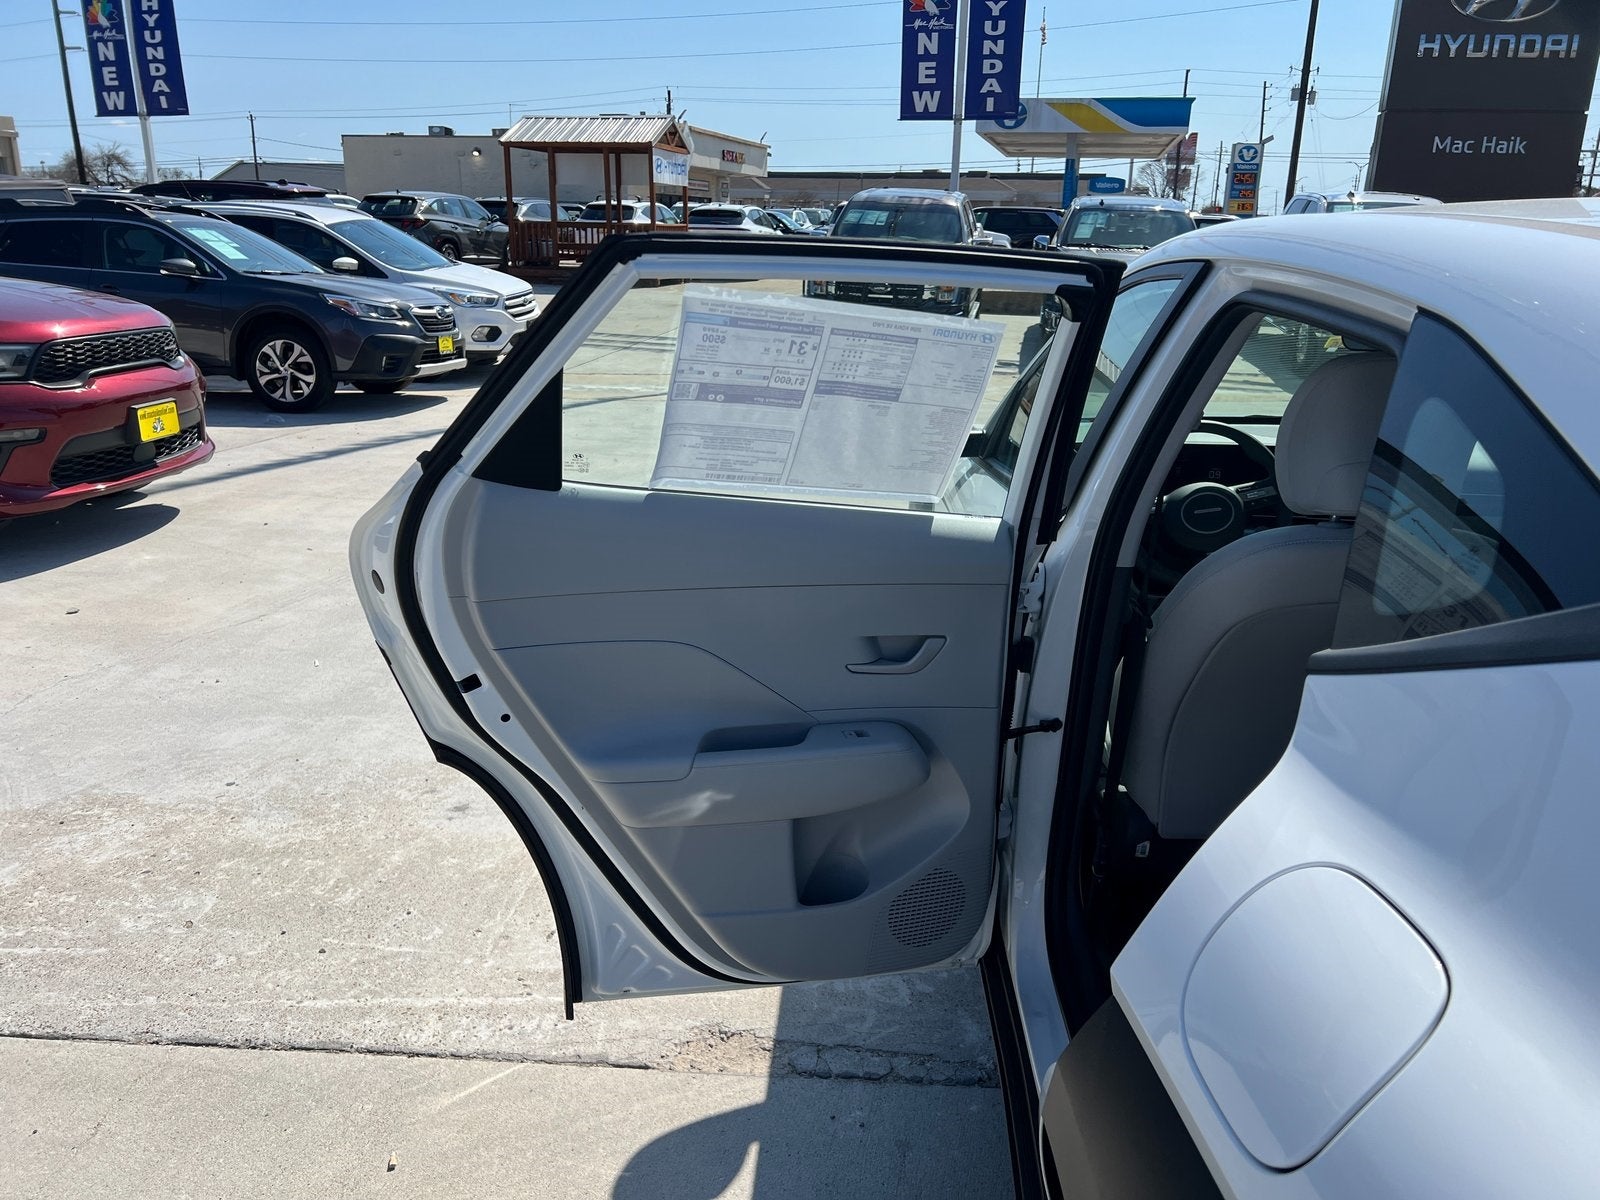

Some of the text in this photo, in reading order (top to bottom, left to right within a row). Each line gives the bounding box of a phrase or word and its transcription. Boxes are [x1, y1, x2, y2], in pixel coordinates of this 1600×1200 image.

[980, 1, 1008, 112] YUNDAI
[1417, 33, 1580, 59] HYUNDAI
[97, 41, 125, 110] NEW
[912, 32, 941, 113] NEW
[1432, 136, 1528, 154] Mac Haik
[1095, 181, 1120, 189] Valero
